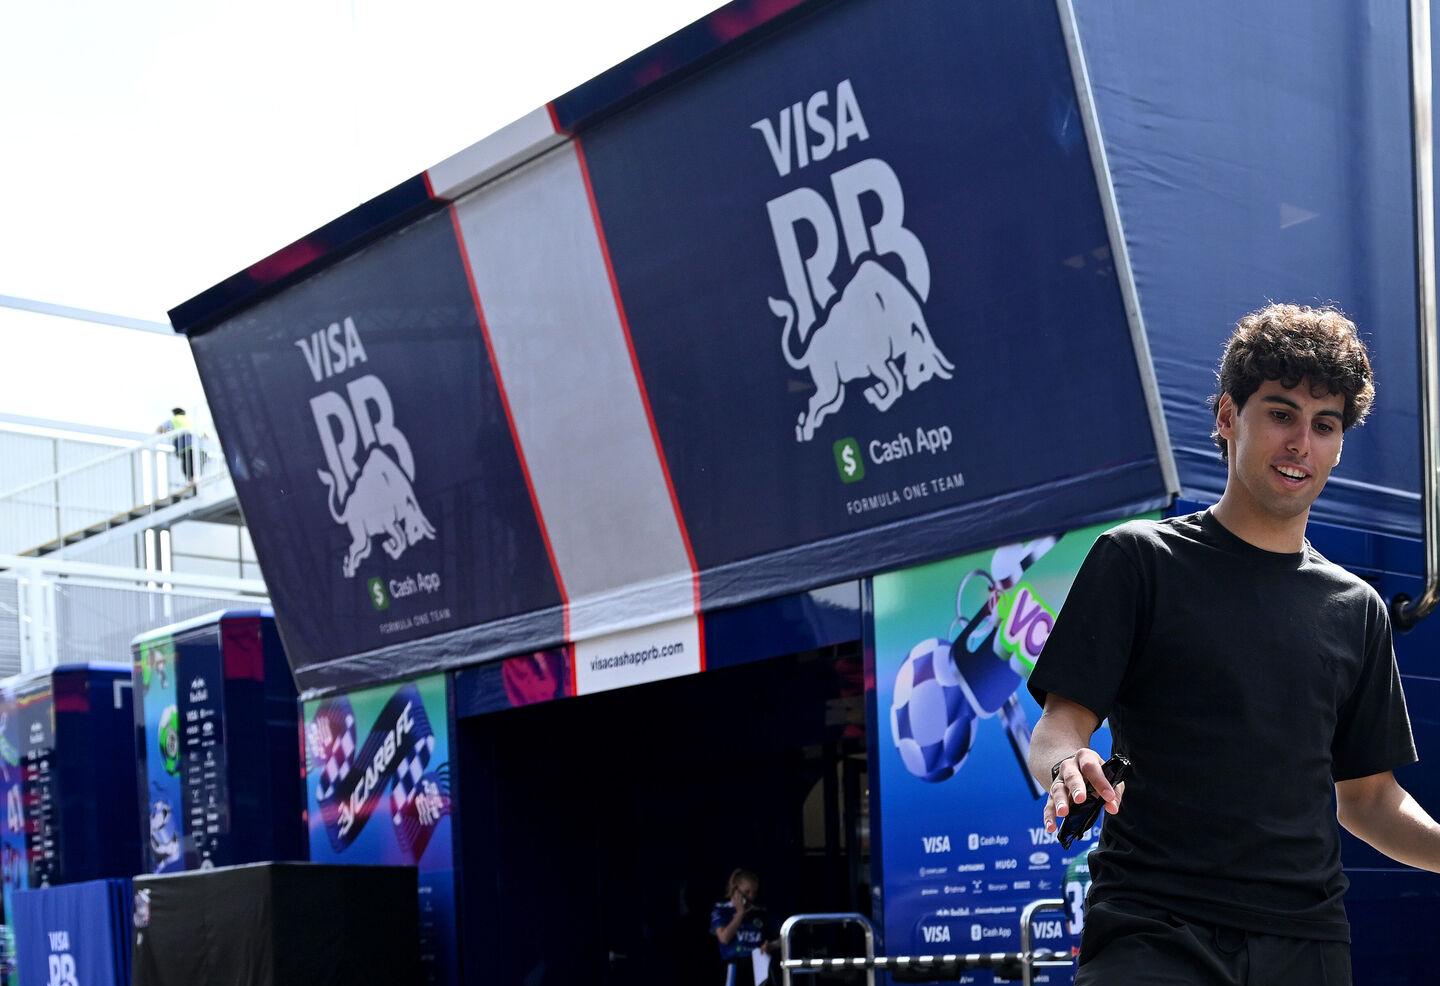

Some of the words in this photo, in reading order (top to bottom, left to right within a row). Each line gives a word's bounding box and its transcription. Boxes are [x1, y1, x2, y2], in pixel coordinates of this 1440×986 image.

[750, 78, 870, 177] VISA
[295, 317, 368, 382] VISA
[869, 432, 914, 464] Cash
[916, 425, 953, 455] App
[846, 490, 900, 515] FORMULA
[903, 482, 928, 501] ONE
[931, 472, 965, 493] TEAM
[389, 576, 418, 599] Cash
[417, 572, 441, 594] App
[413, 613, 430, 627] ONE
[430, 608, 451, 622] TEAM
[590, 641, 685, 672] visacashapprb.com
[922, 835, 951, 853] VISA
[980, 836, 996, 846] Cash
[995, 859, 1018, 870] HUGO
[48, 931, 70, 951] VISA
[922, 926, 951, 942] VISA
[982, 928, 998, 938] Cash
[1032, 920, 1063, 939] VISA
